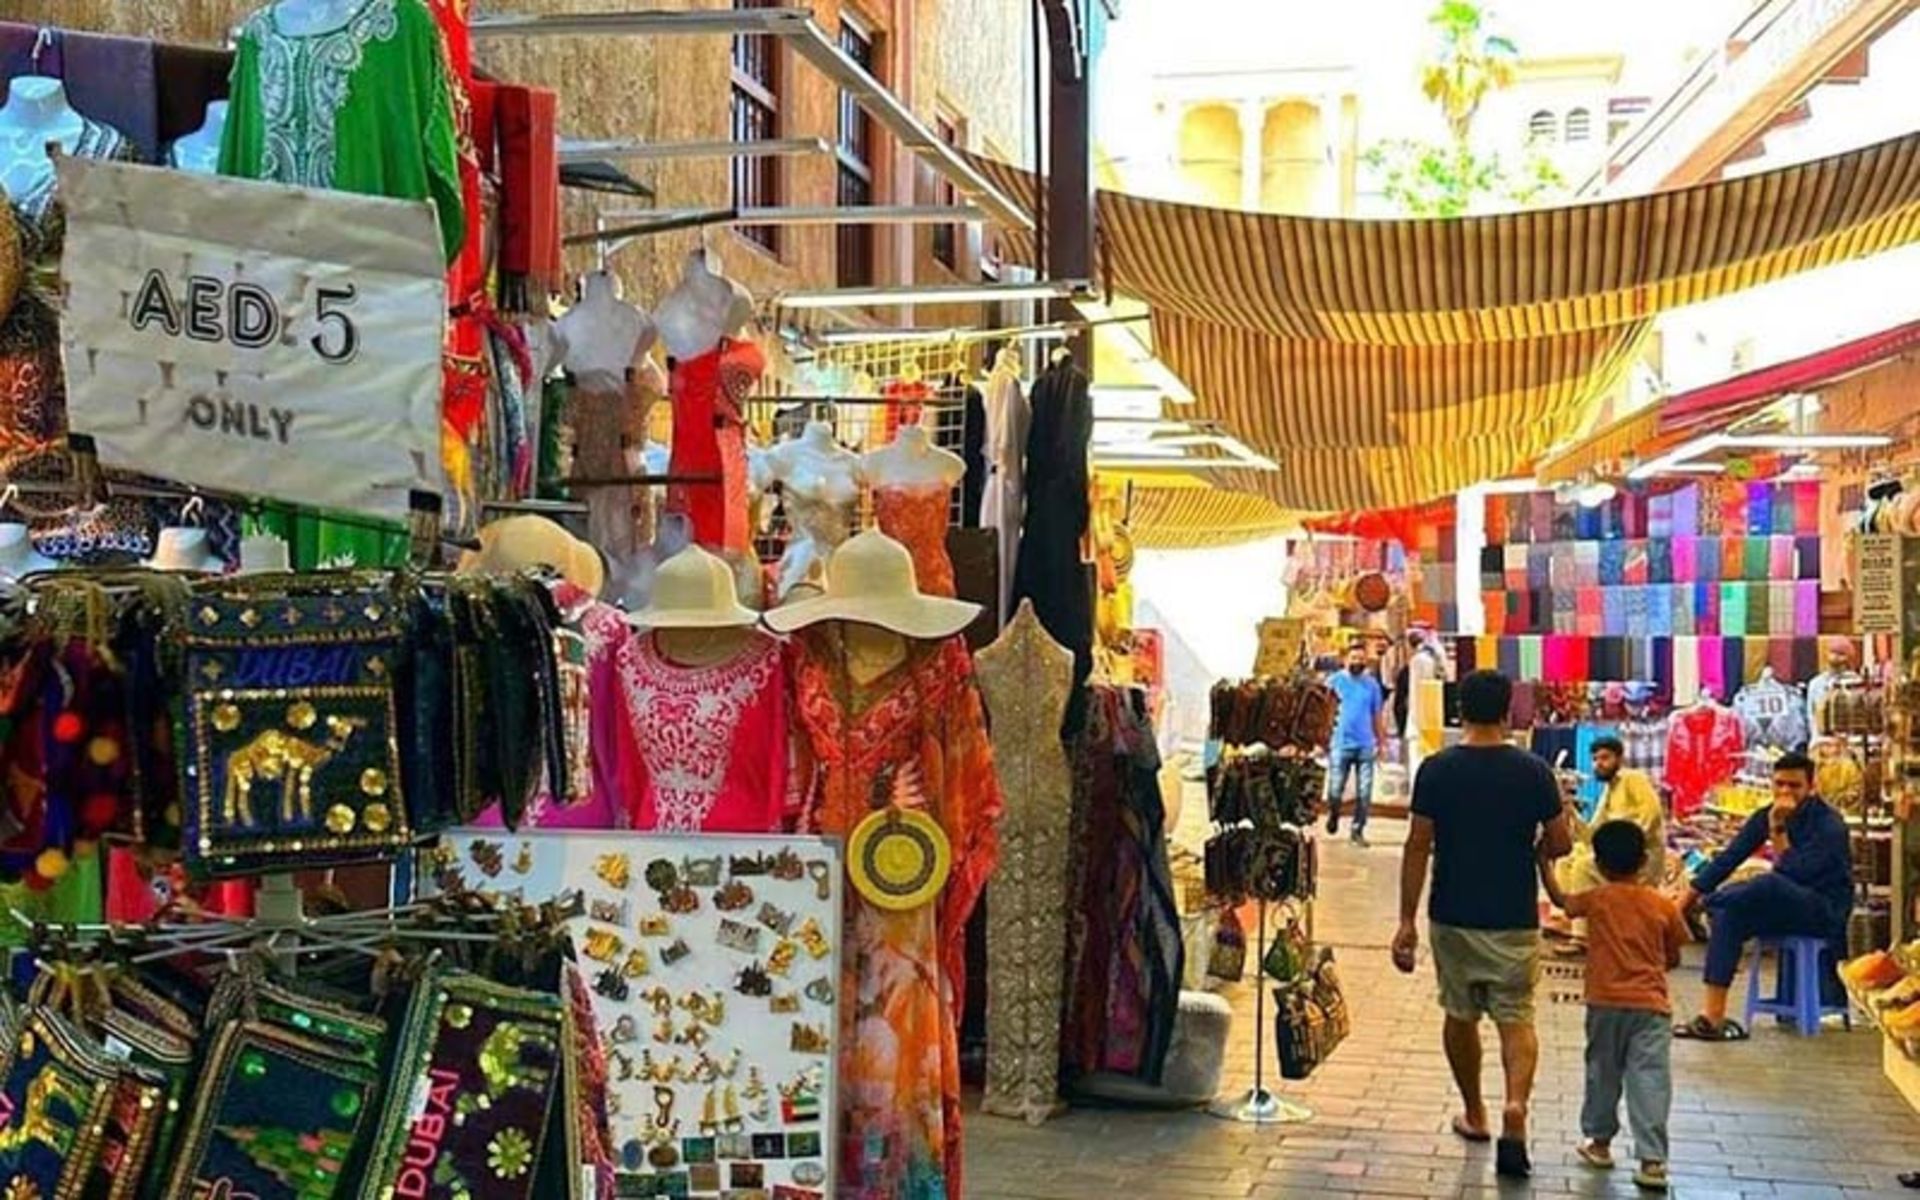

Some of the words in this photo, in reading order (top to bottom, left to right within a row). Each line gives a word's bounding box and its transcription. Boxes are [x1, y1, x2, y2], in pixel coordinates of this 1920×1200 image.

[131, 268, 278, 349] AED
[311, 283, 360, 364] 5
[185, 394, 294, 444] ONLY
[234, 648, 357, 686] DUBAI
[397, 1068, 460, 1198] DUBAI
